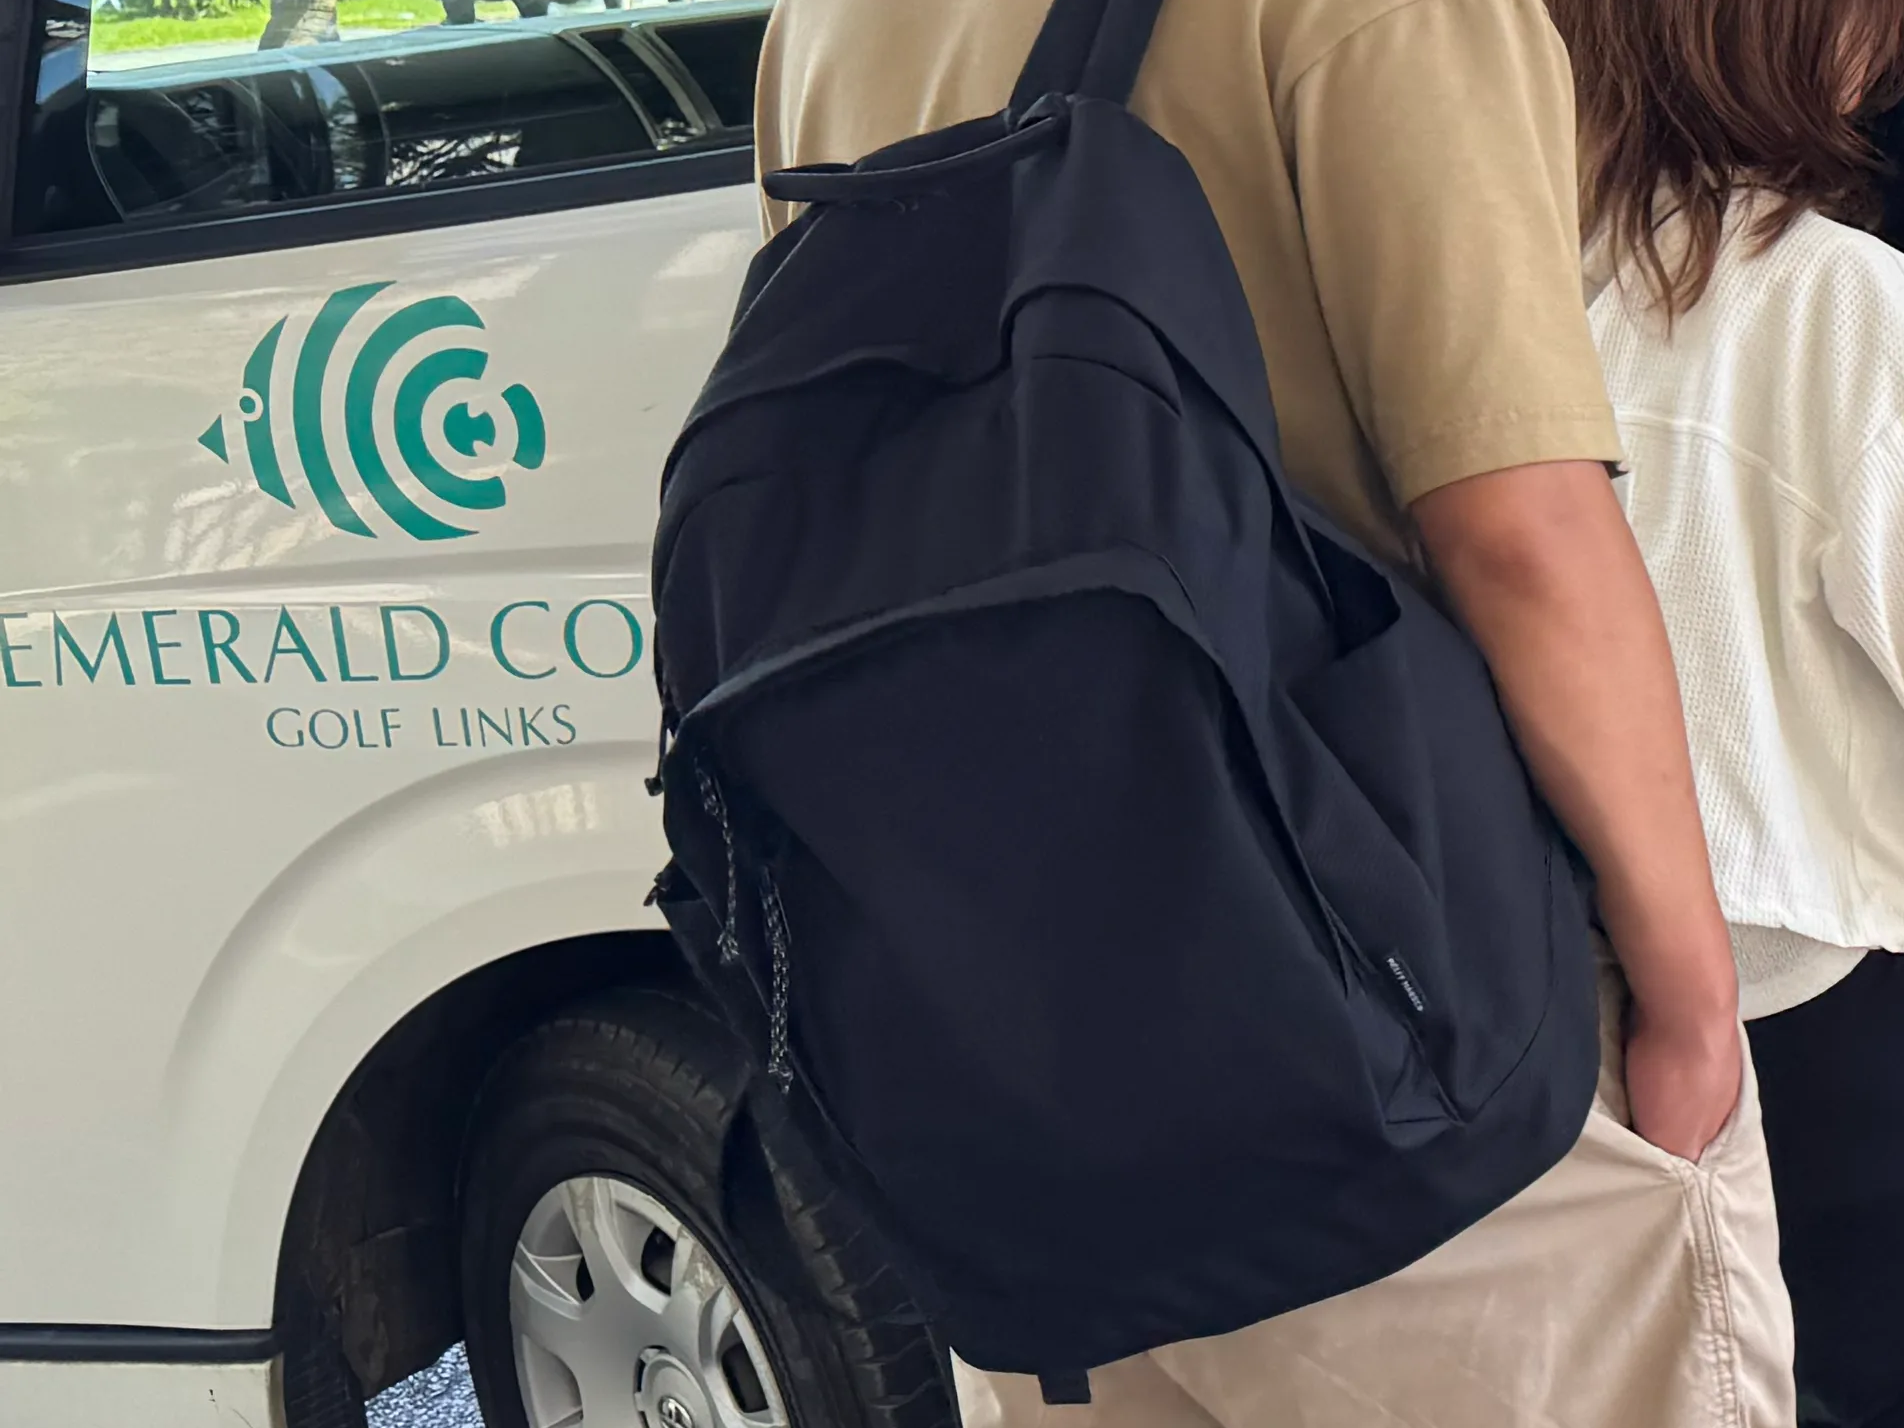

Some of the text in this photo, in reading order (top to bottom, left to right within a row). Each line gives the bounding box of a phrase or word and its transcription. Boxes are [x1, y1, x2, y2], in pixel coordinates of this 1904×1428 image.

[0, 598, 645, 687] EMERALD CO
[266, 704, 578, 749] GOLF LINKS
